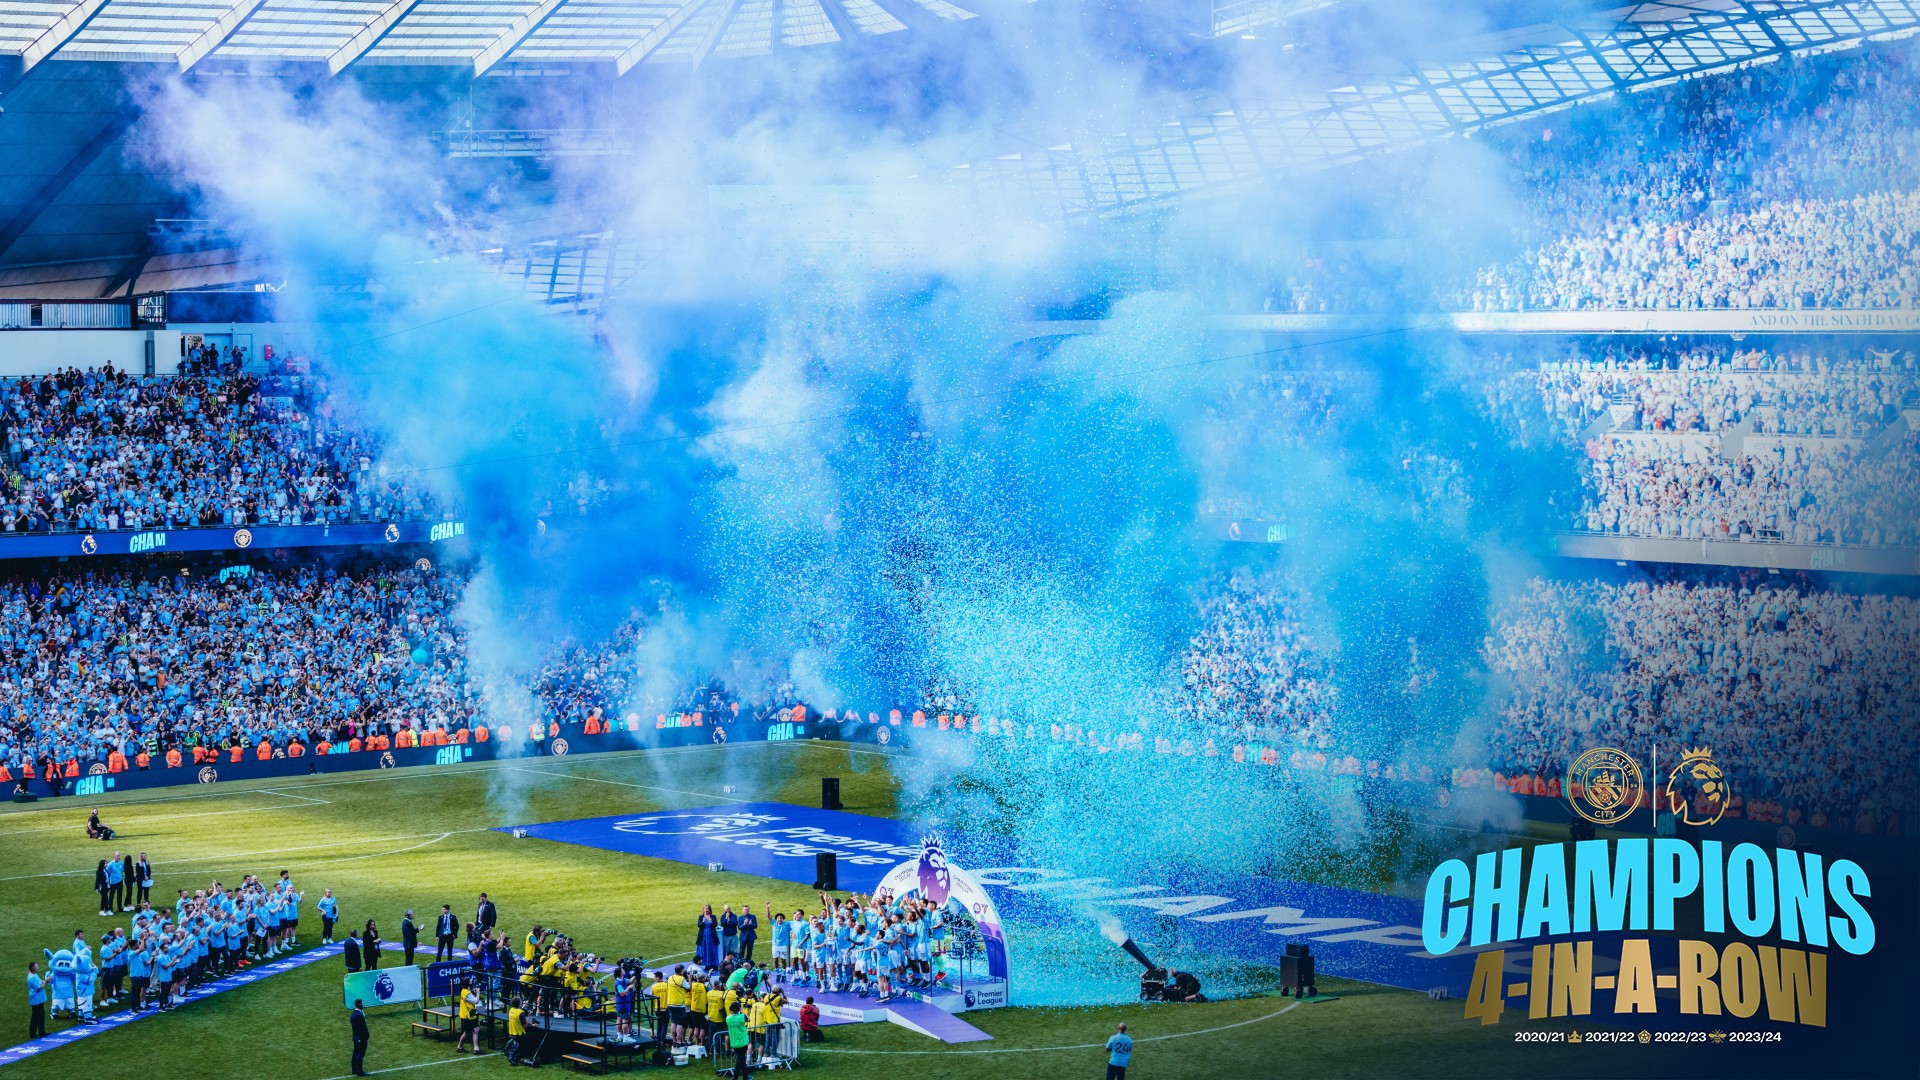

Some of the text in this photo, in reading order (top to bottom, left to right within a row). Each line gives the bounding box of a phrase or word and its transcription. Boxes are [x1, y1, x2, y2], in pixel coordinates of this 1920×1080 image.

[1750, 313, 1777, 326] AND
[1780, 313, 1798, 326] ON
[1802, 314, 1828, 326] THE
[1831, 313, 1872, 326] SIXTH
[1876, 314, 1902, 326] DAY
[756, 826, 922, 858] Premie
[977, 989, 1003, 998] Premier
[977, 996, 1003, 1006] League
